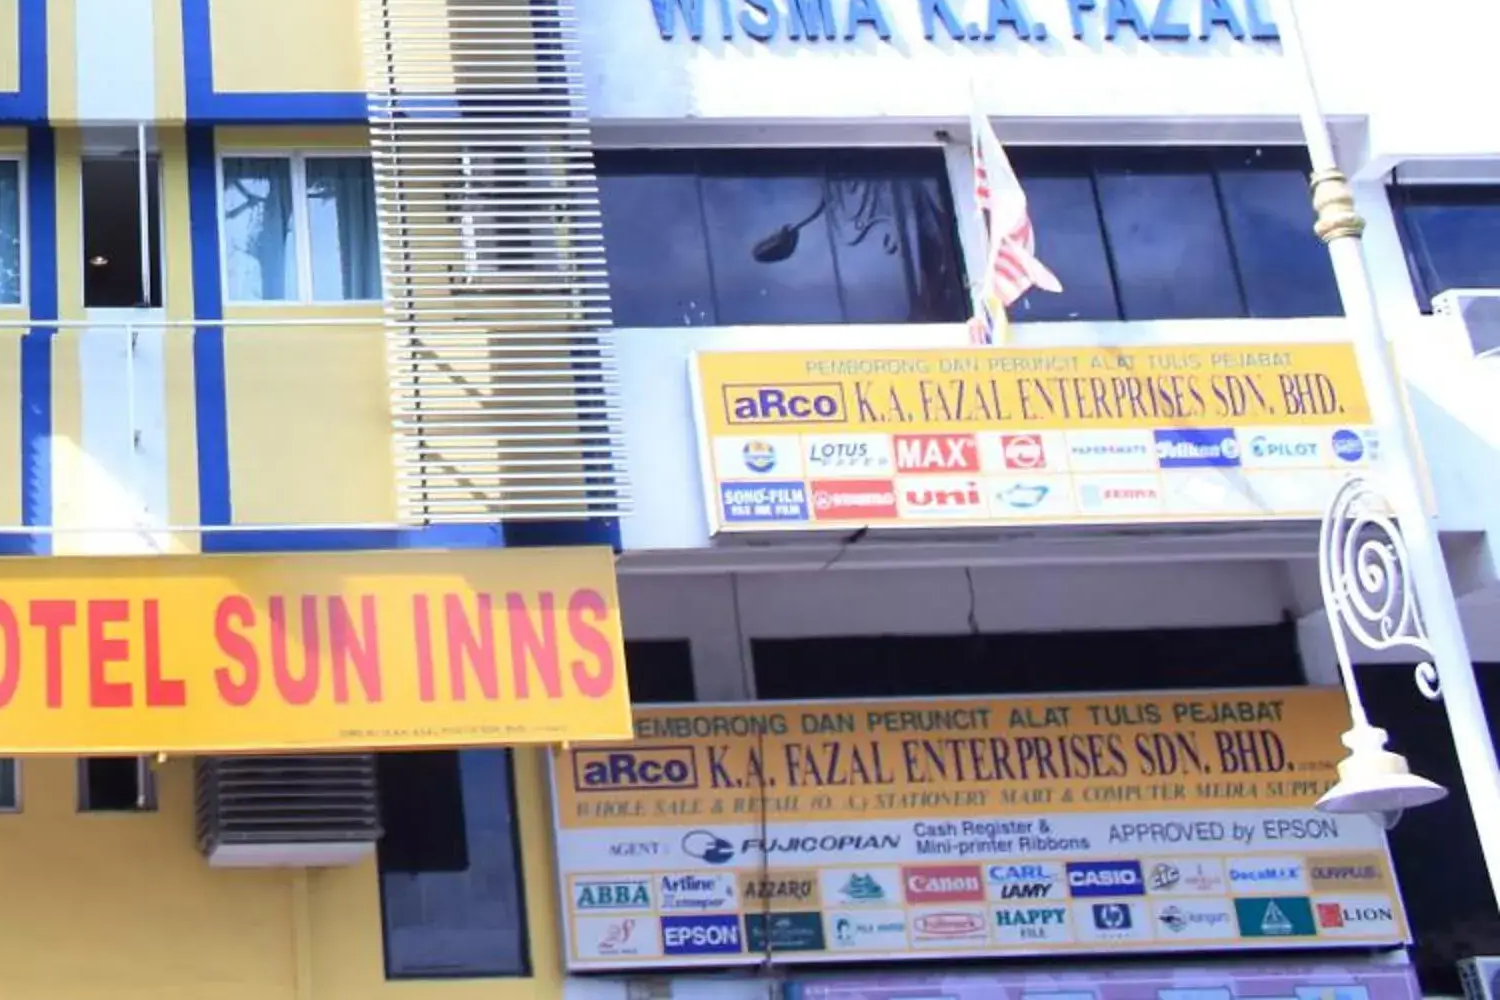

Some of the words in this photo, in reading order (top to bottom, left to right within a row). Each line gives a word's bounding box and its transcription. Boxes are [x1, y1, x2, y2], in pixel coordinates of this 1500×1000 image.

[805, 358, 930, 375] PEMBORONG
[938, 358, 979, 374] DAN
[1149, 353, 1202, 370] TULIS
[734, 389, 838, 420] aRco
[854, 381, 914, 423] K.A.
[918, 379, 1012, 422] FAZAL
[1016, 374, 1206, 421] ENTERPRISES
[1210, 373, 1276, 418] SDN.
[1278, 373, 1345, 416] BHD.
[810, 443, 868, 461] LOTUS
[898, 440, 967, 468] MAX
[1267, 442, 1318, 457] PILOT
[905, 481, 980, 506] uni
[213, 594, 384, 709] SUN
[412, 588, 615, 703] INNS
[633, 713, 788, 739] EMBORONG
[800, 711, 855, 735] DAN
[867, 708, 991, 732] PERUNCIT
[1008, 705, 1071, 729] ALAT
[1087, 702, 1161, 727] TULIS
[1173, 701, 1285, 723] PEJABAT
[583, 754, 689, 785] aRco
[708, 744, 777, 789] K.A.
[784, 741, 895, 788] FAZAL
[901, 732, 1129, 783] ENTERPRISES
[1134, 731, 1212, 776] SDN.
[1213, 729, 1295, 774] BHD.
[1083, 783, 1186, 802] COMPUTER
[913, 822, 951, 838] Cash
[962, 819, 1033, 840] Register
[1038, 818, 1052, 833] &
[1108, 821, 1225, 845] APPROVED
[1232, 824, 1255, 846] by
[1262, 818, 1339, 840] EPSON
[740, 834, 901, 854] FUJICOPIAN
[916, 836, 1014, 856] Mini-printer
[1018, 833, 1091, 853] Ribbons
[661, 874, 716, 892] Artline
[988, 863, 1049, 882] CARL
[1069, 869, 1137, 887] CASIO
[576, 884, 651, 907] ABBA
[907, 875, 980, 894] Canon
[1001, 883, 1053, 900] LAMY
[995, 908, 1067, 928] HAPPY
[1343, 908, 1394, 923] LION
[664, 925, 740, 948] EPSON
